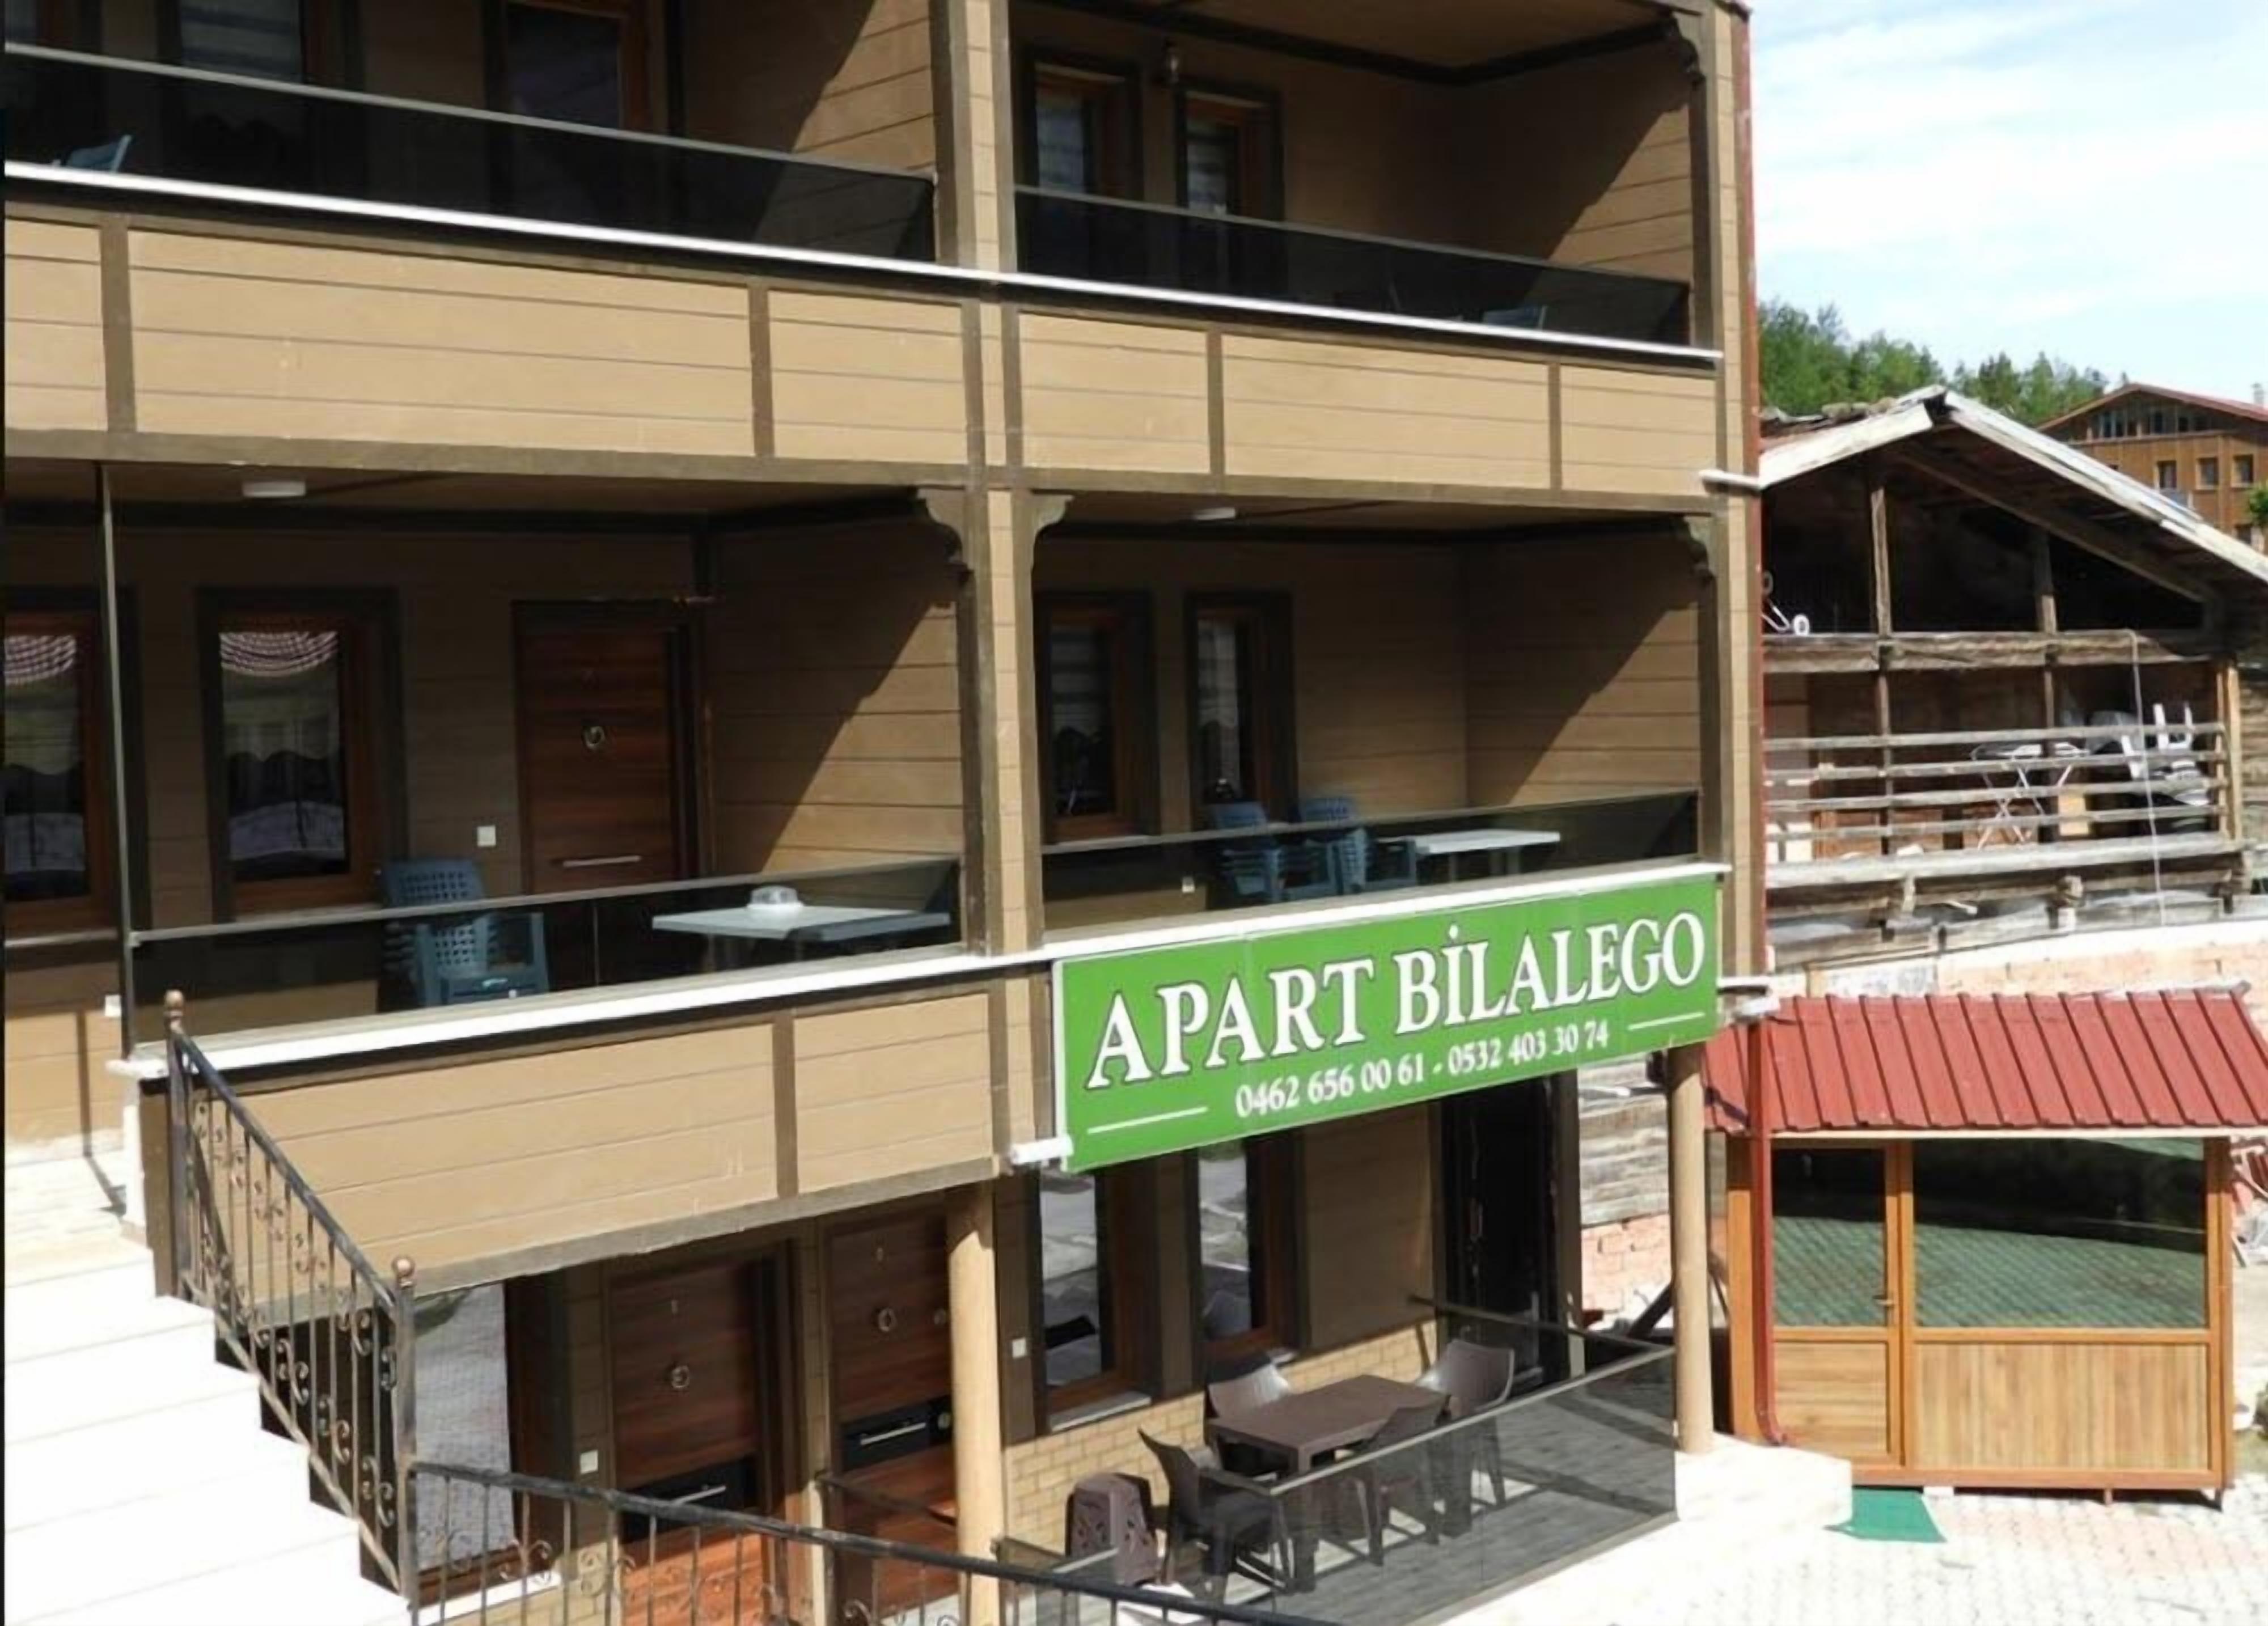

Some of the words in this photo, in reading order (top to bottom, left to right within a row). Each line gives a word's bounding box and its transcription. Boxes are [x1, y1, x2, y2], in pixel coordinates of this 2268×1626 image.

[1086, 959, 1374, 1089] APART
[1394, 912, 1704, 1034] BİLALEGO
[1235, 1076, 1300, 1119] 0462
[1308, 1064, 1354, 1104] 656
[1360, 1058, 1393, 1092] 00
[1398, 1053, 1425, 1087] 61
[1448, 1042, 1503, 1074] 0532
[1509, 1033, 1548, 1064] 403
[1551, 1028, 1580, 1056] 30
[1583, 1021, 1609, 1050] 74
